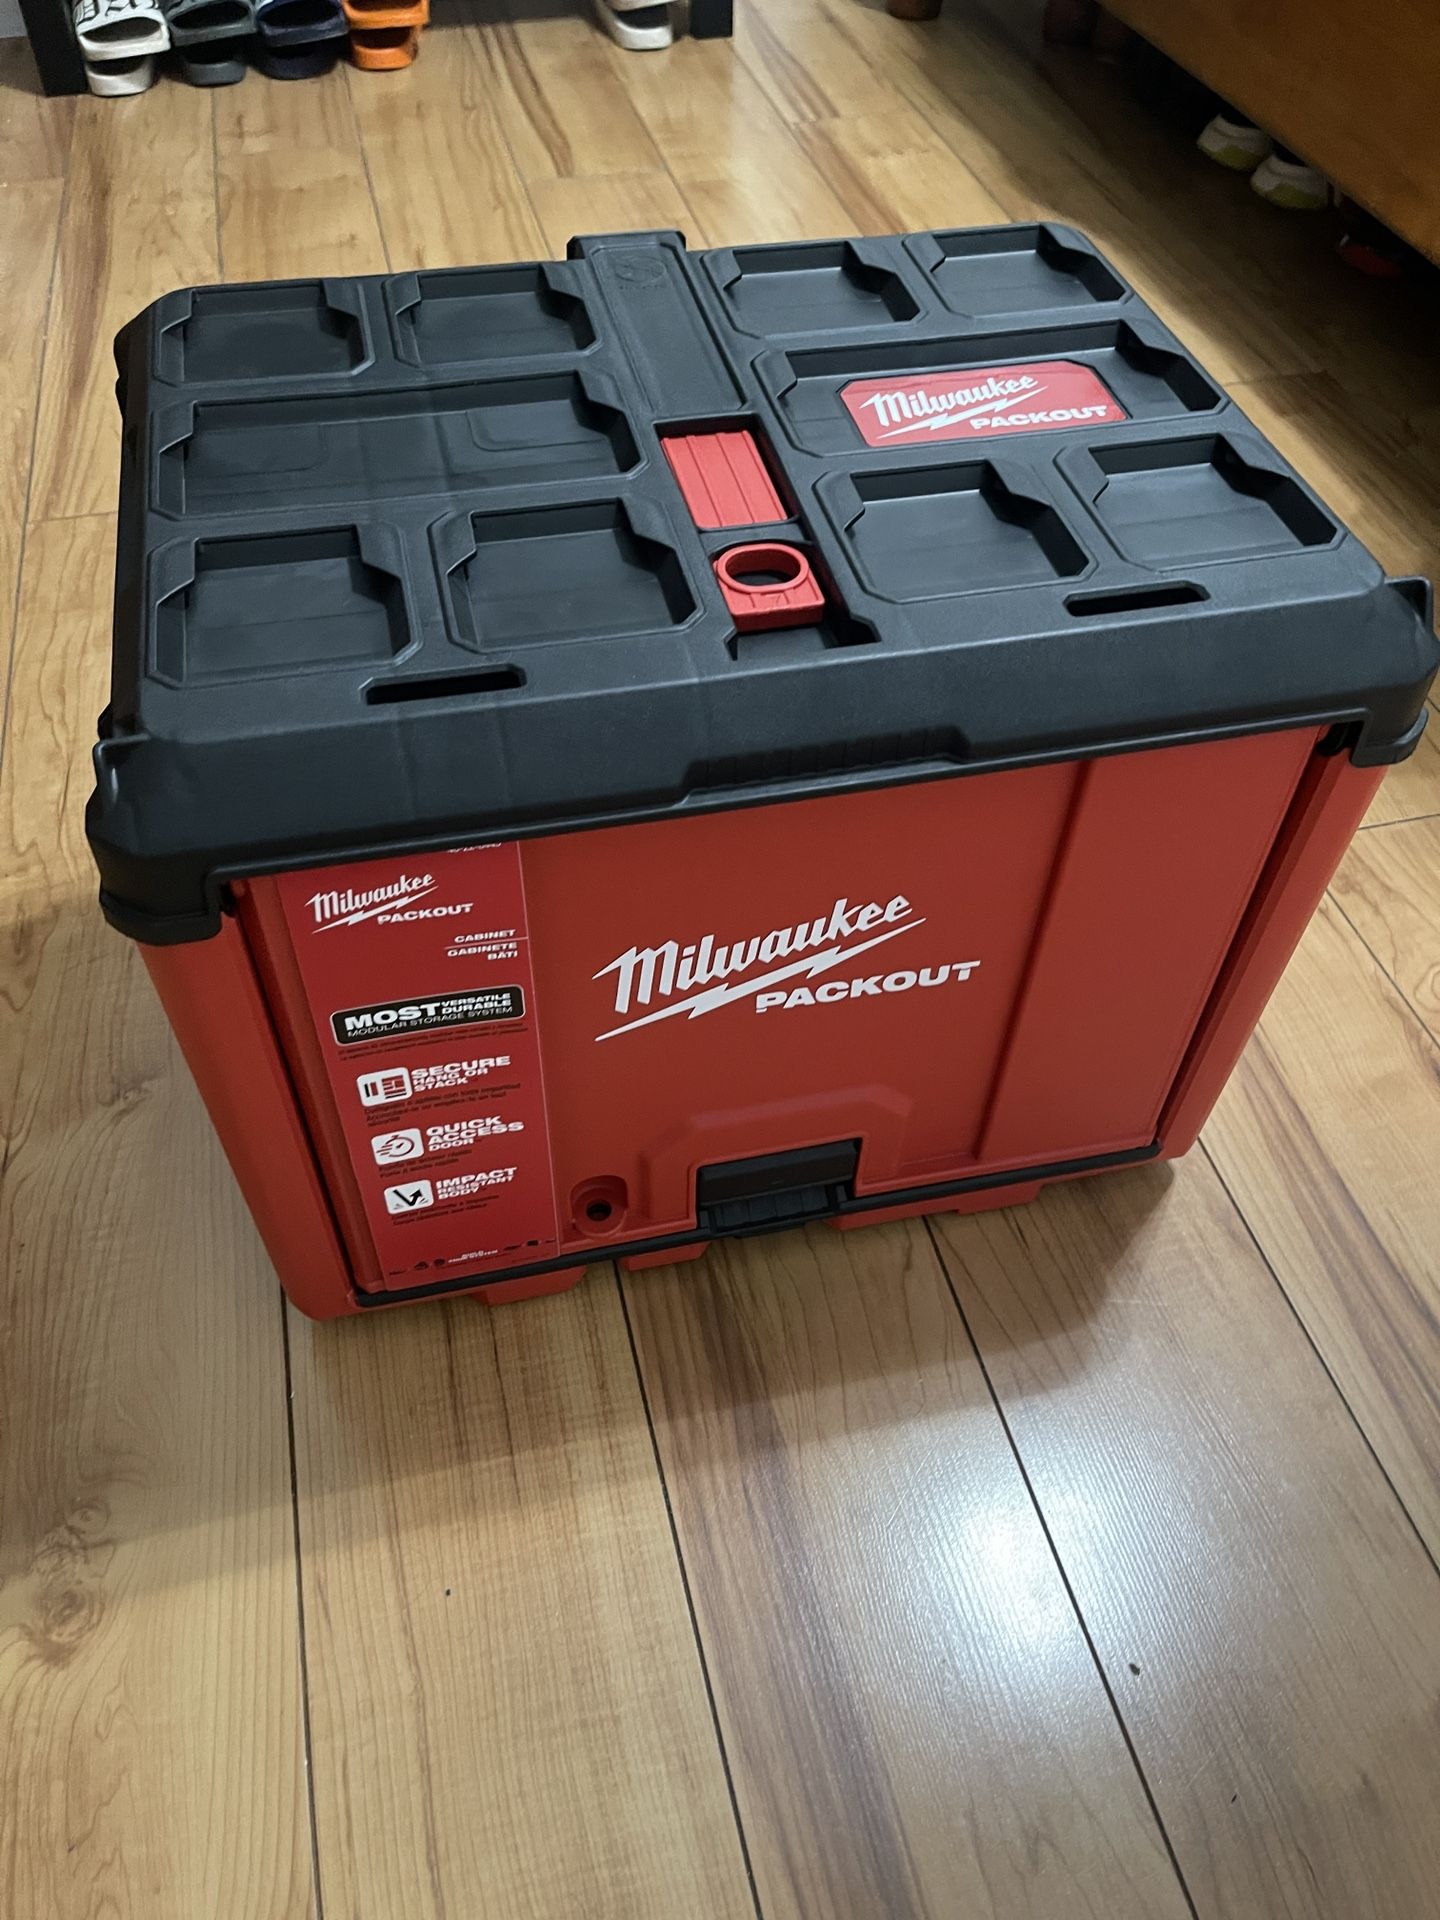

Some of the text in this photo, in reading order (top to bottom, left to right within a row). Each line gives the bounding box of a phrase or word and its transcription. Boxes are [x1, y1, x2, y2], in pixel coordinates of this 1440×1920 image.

[858, 374, 1038, 427] Milwaukee
[970, 405, 1108, 430] PACKOUT
[304, 872, 436, 923] Milwaukee
[377, 902, 474, 925] PACKOUT
[454, 929, 516, 943] CABINET
[592, 894, 914, 1014] Milwaukee
[756, 959, 981, 1014] PACKOUT
[441, 992, 511, 1007] VERSATILE
[442, 999, 512, 1015] DURABLE
[344, 1003, 442, 1030] MOST
[347, 1006, 513, 1038] MODULAR STORAGE SYSTEM
[411, 1055, 511, 1079] SECURE
[412, 1067, 489, 1086] HANG OR
[413, 1077, 469, 1092] STACK
[426, 1115, 502, 1137] QUICK
[427, 1121, 524, 1146] ACCESS
[428, 1138, 474, 1152] DOOR
[435, 1166, 518, 1190] IMPACT
[437, 1176, 514, 1195] RESISTANT
[438, 1187, 480, 1200] BODY
